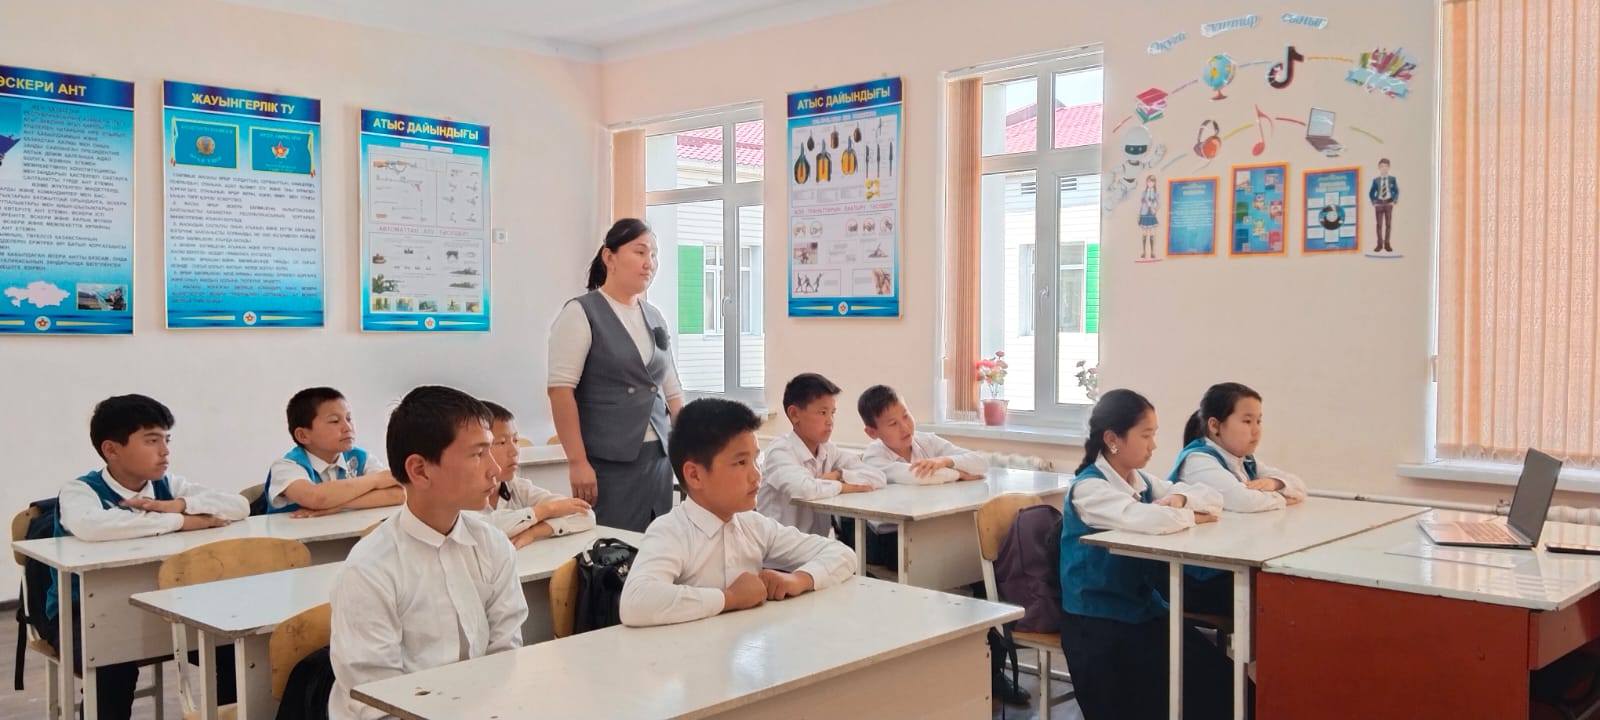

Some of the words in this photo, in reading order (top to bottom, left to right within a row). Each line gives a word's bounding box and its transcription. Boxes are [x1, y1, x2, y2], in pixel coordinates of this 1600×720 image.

[58, 83, 88, 97] АНТ
[797, 97, 824, 110] АТЫС
[825, 86, 890, 108] ДАЙЫНДЫҒЫ
[191, 92, 278, 113] ЖАУЫНГЕРЛІК
[281, 103, 295, 114] ТУ
[373, 117, 405, 131] АТЫС
[406, 121, 479, 140] ДАЙЫНДЫҒЫ
